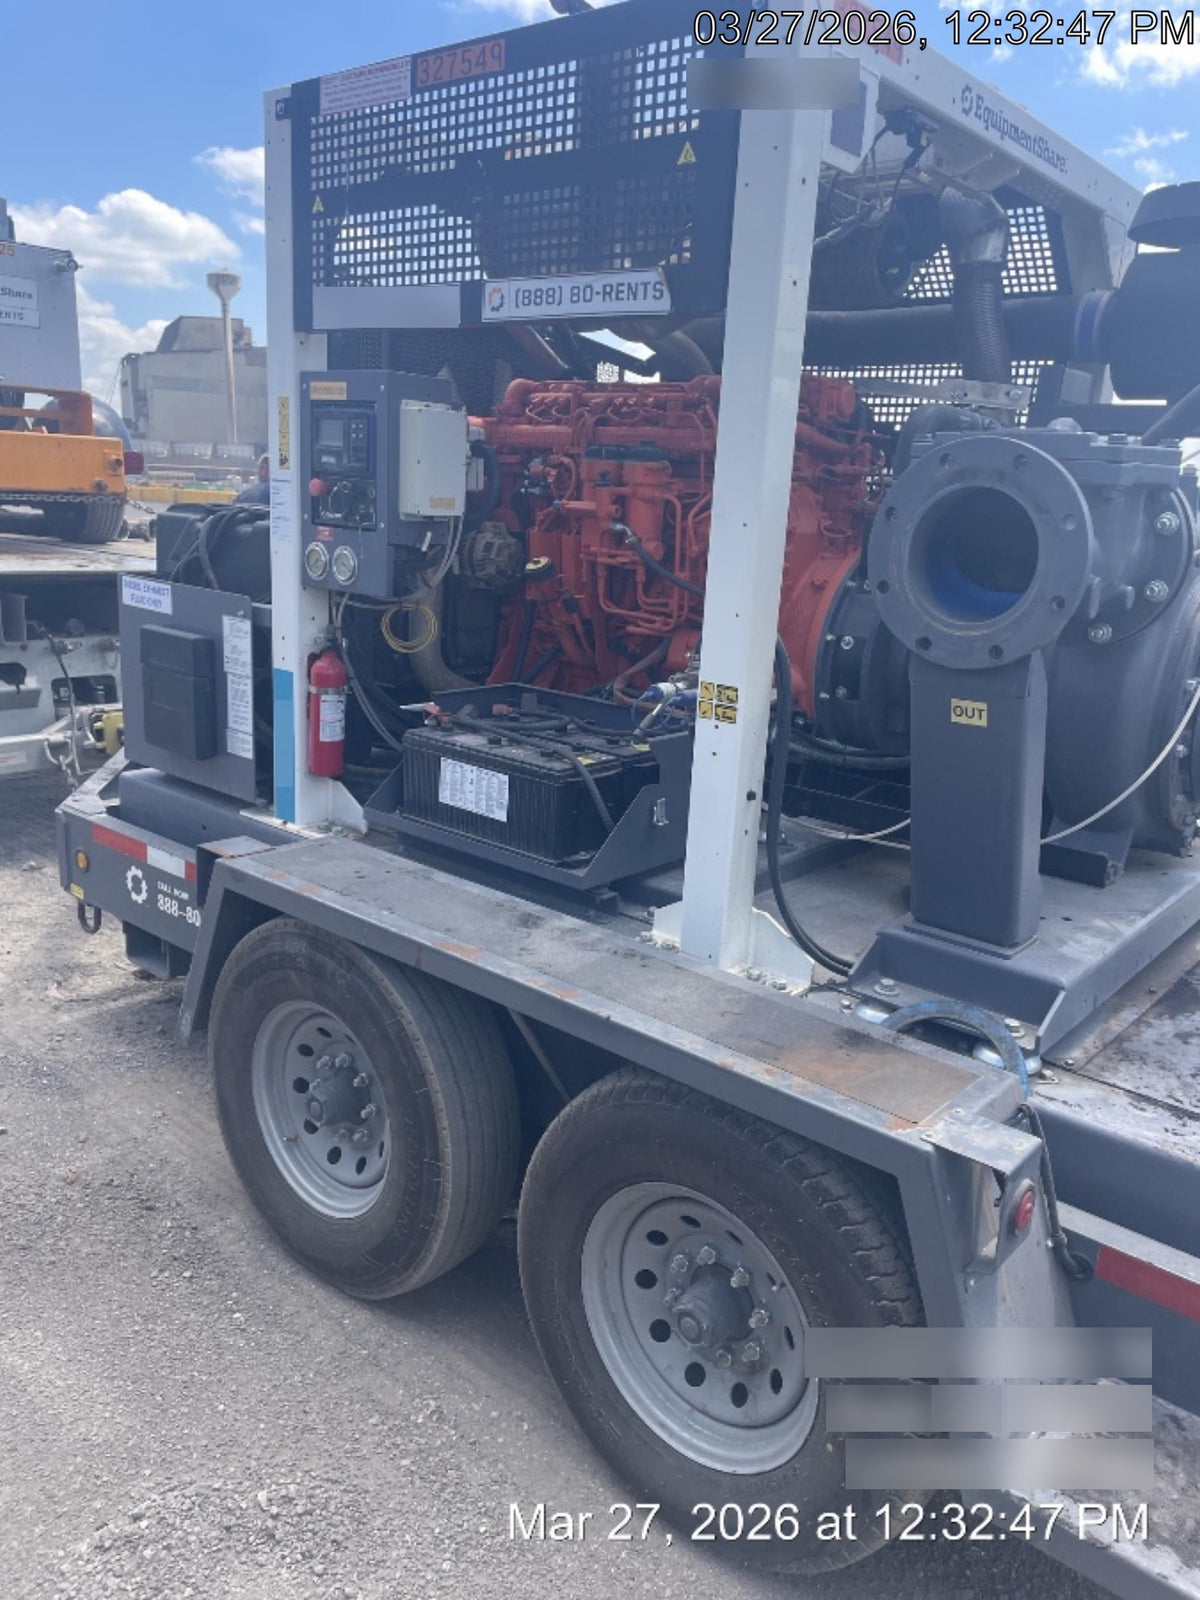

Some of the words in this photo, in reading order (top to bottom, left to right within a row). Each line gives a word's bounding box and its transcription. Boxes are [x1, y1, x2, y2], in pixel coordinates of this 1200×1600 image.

[418, 41, 503, 85] 327549
[514, 286, 563, 310] (888)
[569, 280, 665, 305] 80-RENTS
[952, 705, 986, 721] OUT
